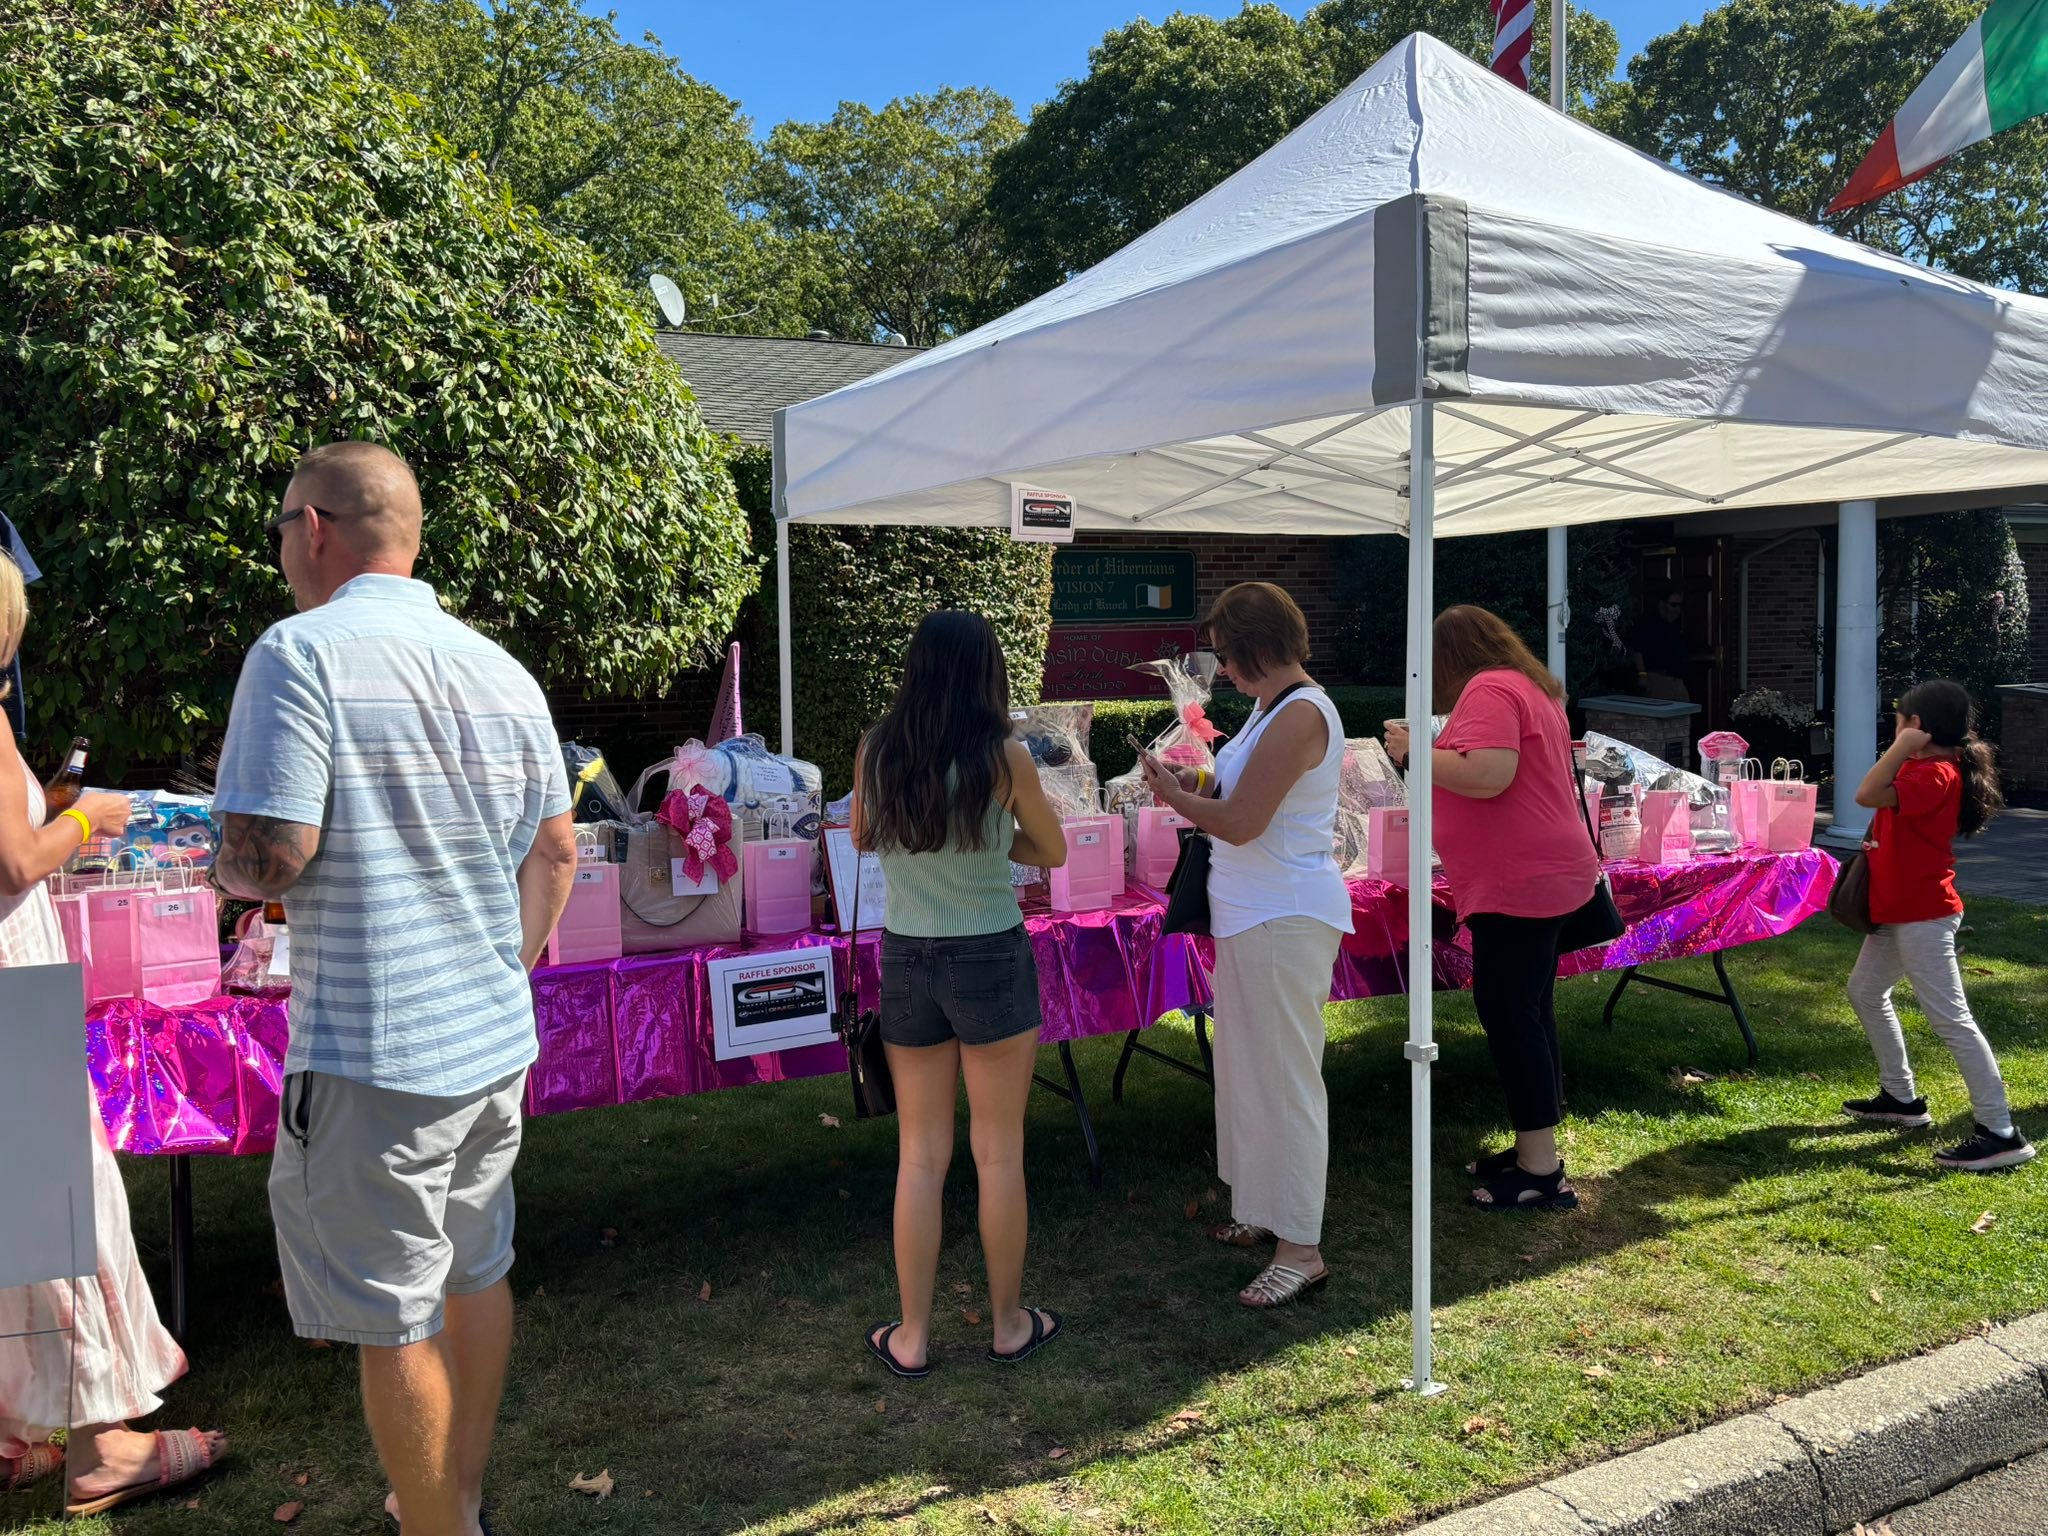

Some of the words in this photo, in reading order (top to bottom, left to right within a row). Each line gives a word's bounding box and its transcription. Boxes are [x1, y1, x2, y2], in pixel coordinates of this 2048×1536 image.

[1053, 559, 1082, 575] rder
[1087, 559, 1100, 575] of
[1104, 557, 1176, 576] Hibernians
[1056, 581, 1104, 594] VISION
[1107, 581, 1115, 593] 7
[1083, 599, 1093, 611] of
[1098, 598, 1129, 611] Knock
[584, 847, 594, 856] 29
[582, 872, 591, 880] 29
[117, 899, 129, 907] 25
[168, 903, 179, 912] 26
[738, 968, 772, 981] RAFFLE
[773, 962, 816, 976] SPONSOR
